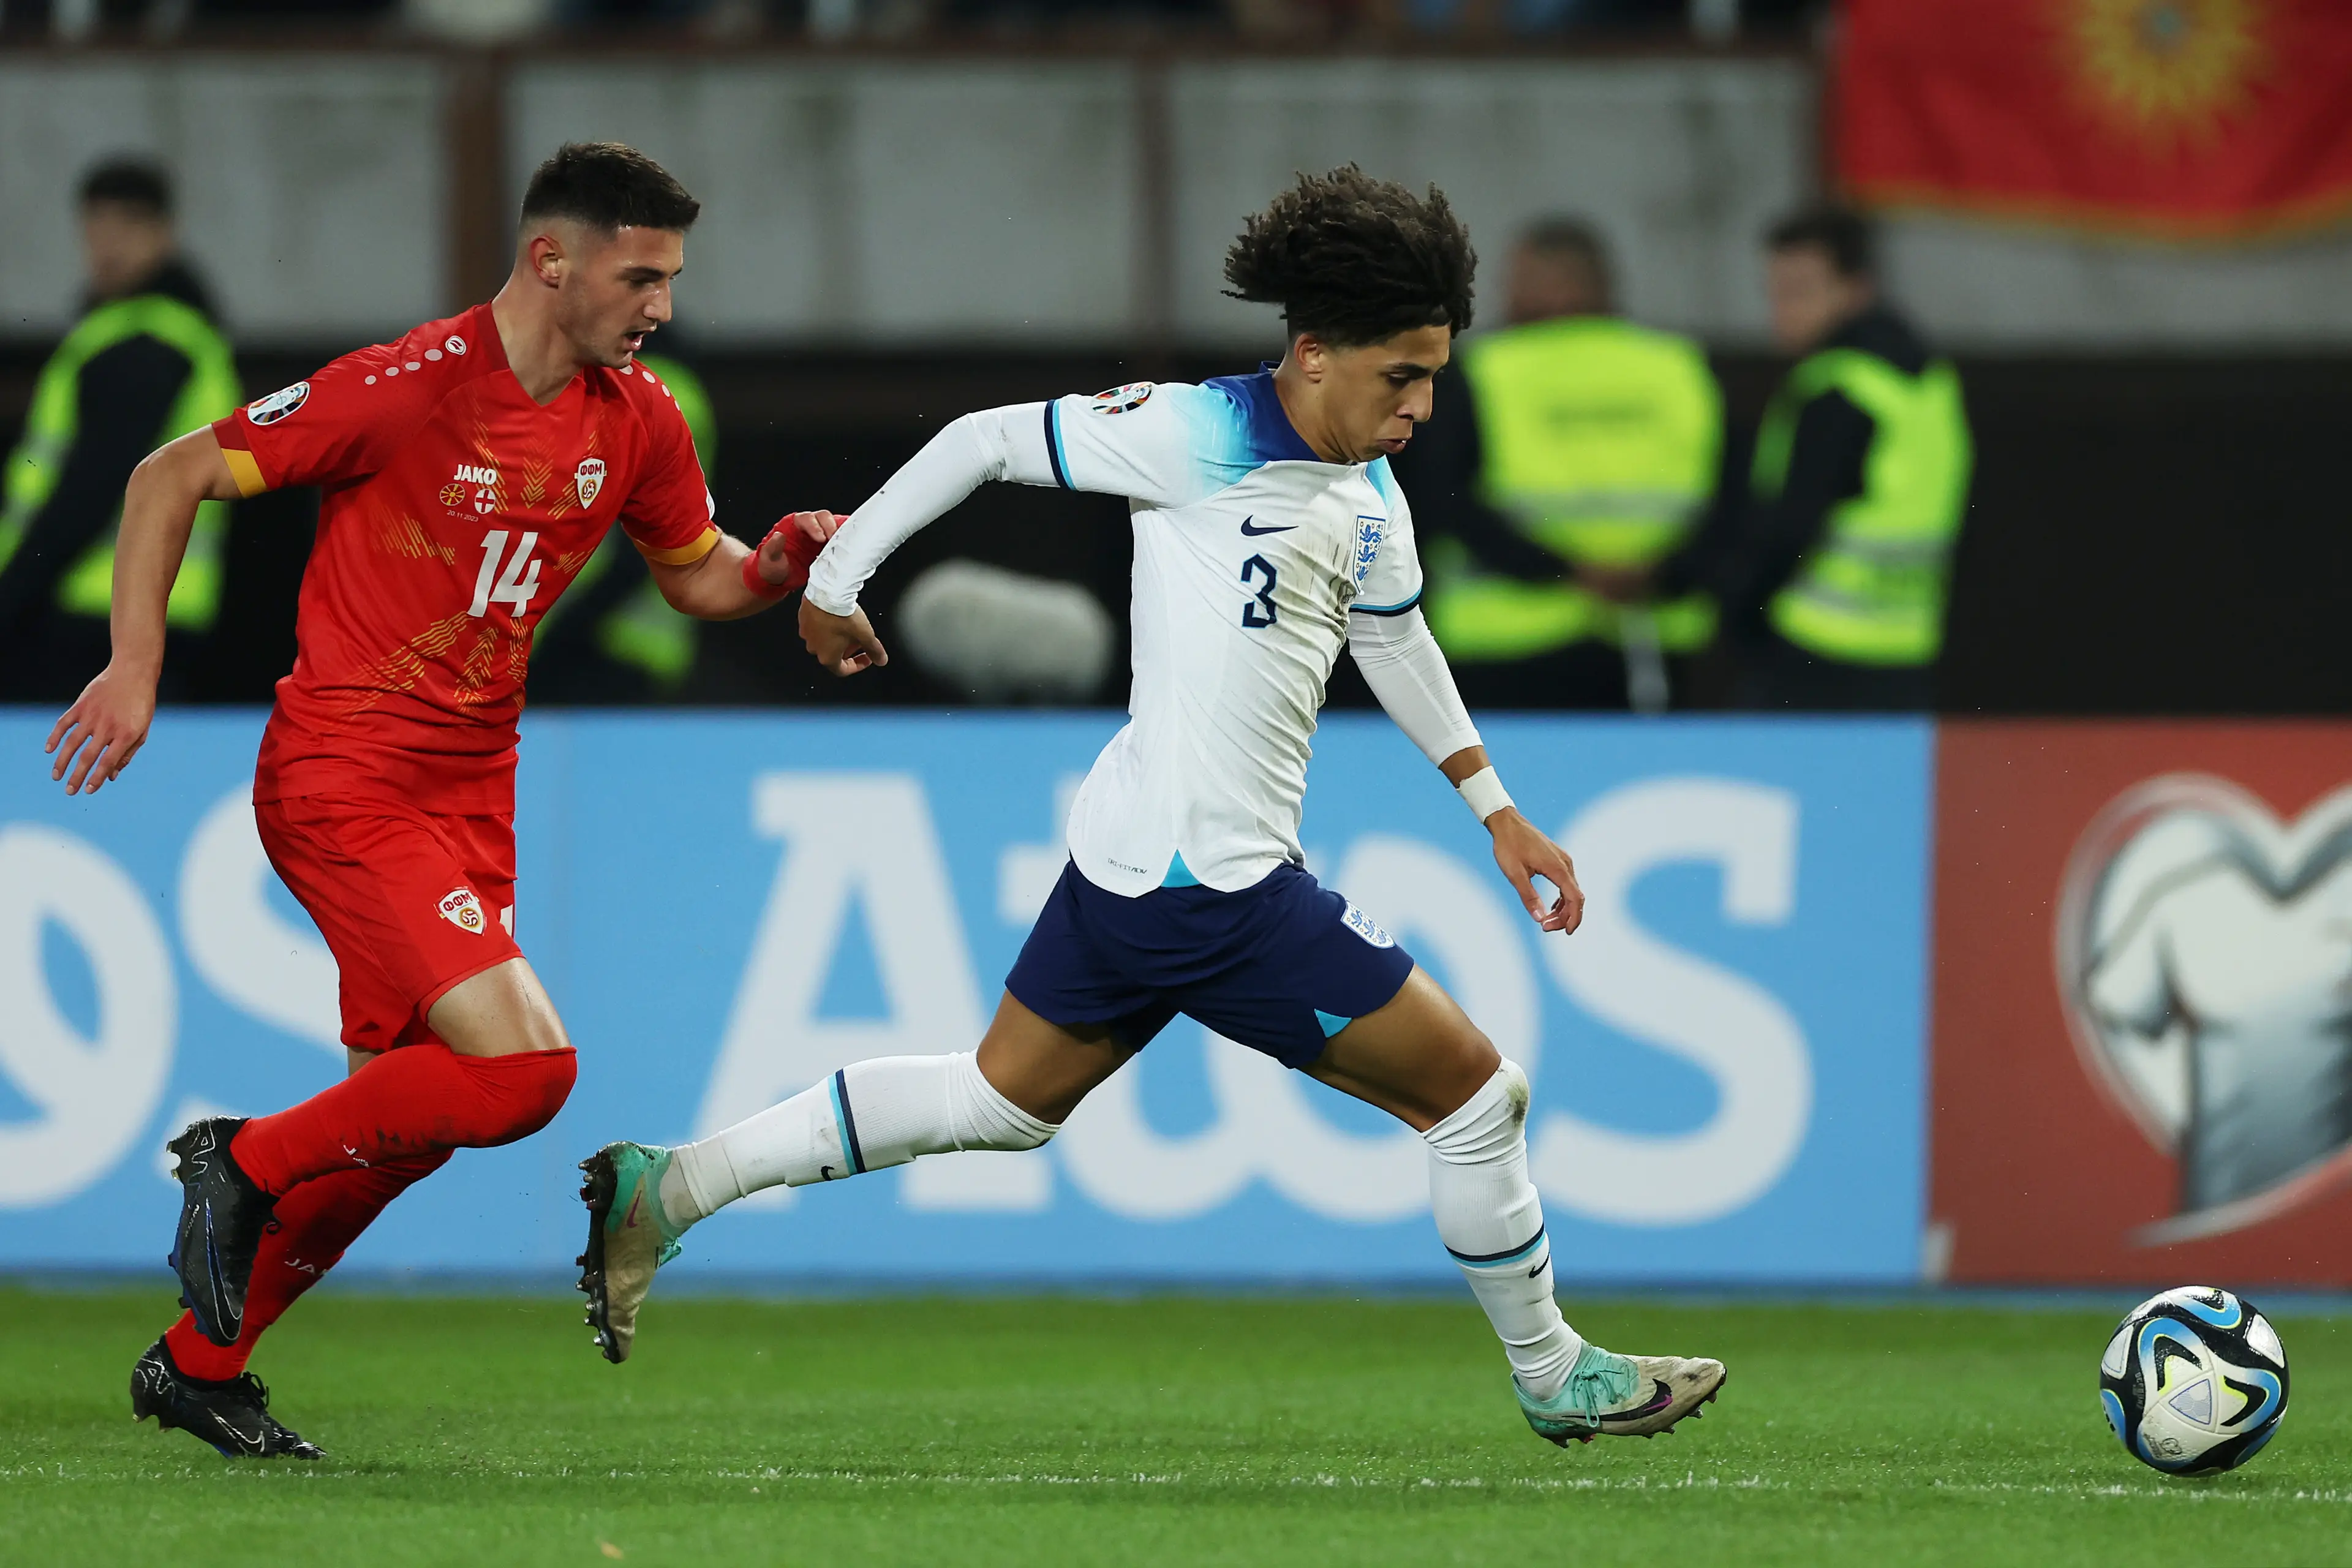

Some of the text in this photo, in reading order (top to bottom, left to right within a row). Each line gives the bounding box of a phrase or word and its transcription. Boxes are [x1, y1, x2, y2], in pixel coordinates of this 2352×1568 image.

[453, 464, 497, 485] JAKO
[467, 530, 542, 617] 14
[1240, 553, 1277, 628] 3
